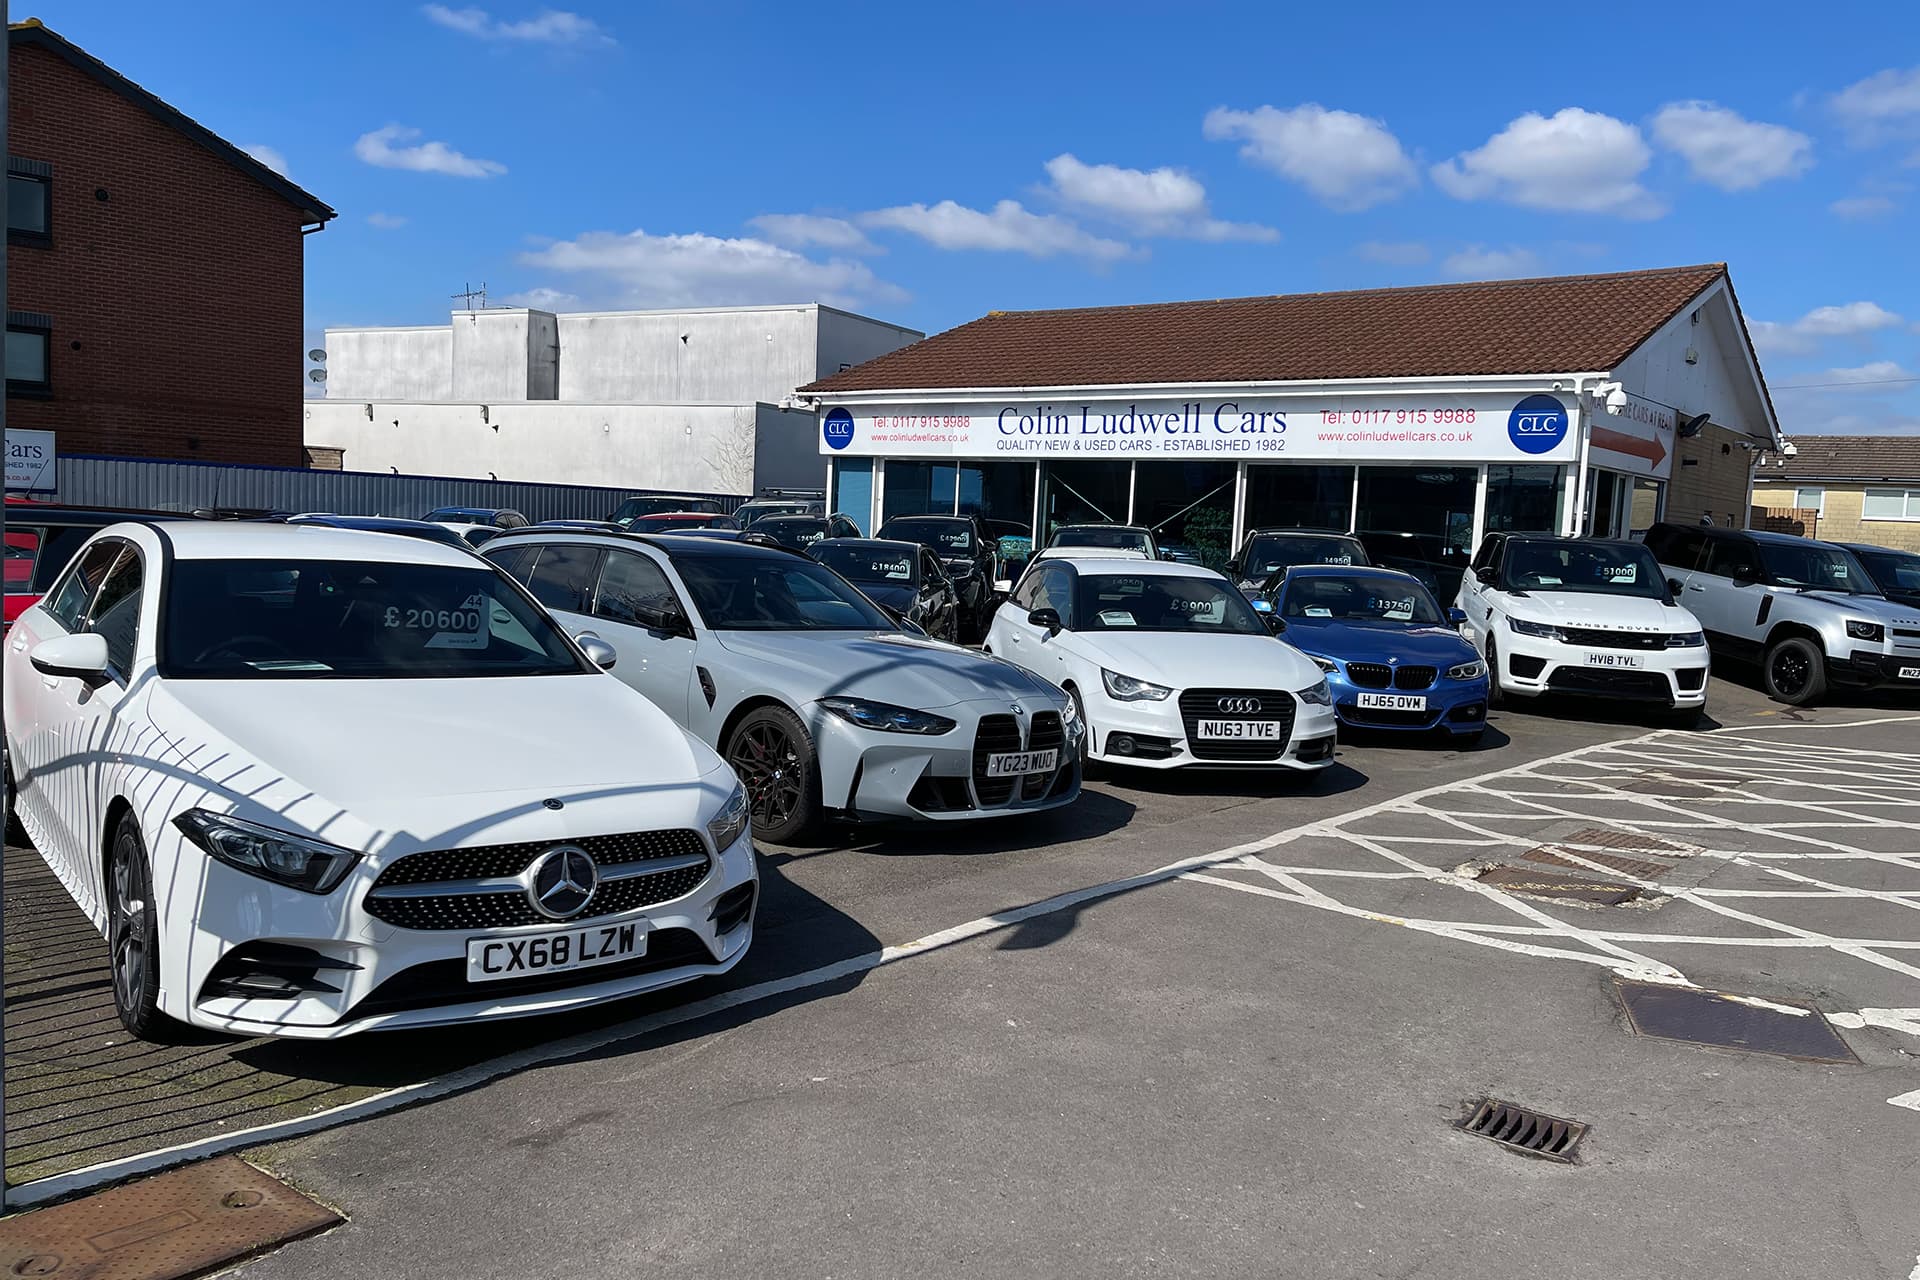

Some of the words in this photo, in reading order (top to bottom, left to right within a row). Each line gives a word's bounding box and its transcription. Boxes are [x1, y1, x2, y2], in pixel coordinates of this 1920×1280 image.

[872, 415, 889, 428] Tel:
[892, 415, 917, 428] 0117
[920, 415, 940, 428] 915
[943, 415, 970, 428] 9988
[998, 406, 1069, 435] Colin
[1080, 404, 1202, 434] Ludwell
[1213, 402, 1287, 434] Cars
[1320, 410, 1346, 424] Tel:
[1352, 409, 1391, 424] 0117
[1396, 409, 1427, 424] 915
[1433, 408, 1476, 424] 9988
[828, 422, 849, 435] CLC
[1518, 416, 1558, 432] CLC
[871, 432, 969, 443] www.colinludwellcars.co.uk
[1317, 430, 1473, 442] www.colinludwellcars.co.uk
[996, 439, 1042, 451] QUALITY
[1044, 439, 1070, 451] NEW
[1073, 439, 1081, 451] &
[1084, 439, 1116, 451] USED
[1119, 439, 1152, 451] CARS
[1163, 439, 1251, 451] ESTABLISHED
[1255, 439, 1285, 451] 1982
[467, 596, 482, 607] 44
[1170, 599, 1212, 613] £9900
[384, 606, 480, 630] £20600
[1567, 621, 1609, 629] RANGE
[1617, 624, 1660, 632] ROVER
[1590, 654, 1614, 665] HV18
[1616, 655, 1637, 667] TVL
[1362, 694, 1395, 707] HJ65
[1397, 697, 1421, 709] OVM
[1204, 722, 1243, 736] NU63
[1247, 723, 1274, 737] TVE
[995, 754, 1030, 773] YG23
[483, 935, 570, 974] CX68
[578, 923, 636, 962] LZW
